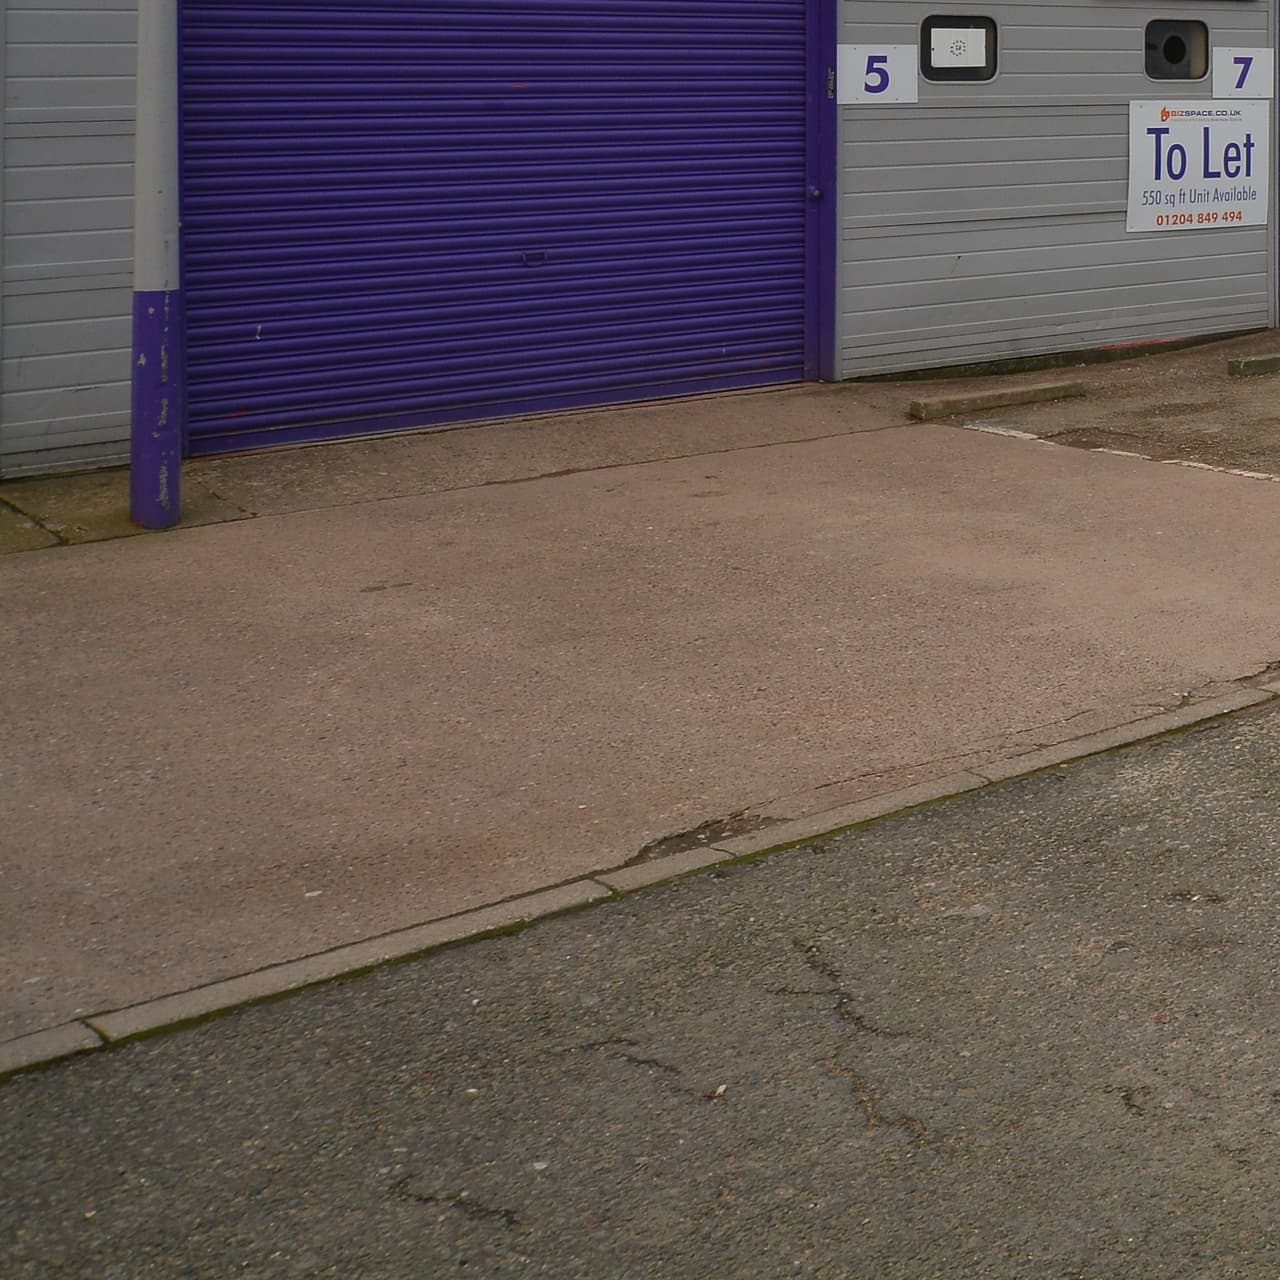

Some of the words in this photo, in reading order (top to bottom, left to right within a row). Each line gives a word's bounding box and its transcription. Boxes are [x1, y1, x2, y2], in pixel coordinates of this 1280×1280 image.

[864, 55, 890, 94] 5
[1233, 56, 1254, 89] 7
[1146, 127, 1187, 181] To
[1203, 126, 1255, 179] Let
[1142, 190, 1162, 206] 550
[1164, 192, 1175, 207] sq
[1179, 188, 1186, 204] ft
[1189, 188, 1210, 204] Unit
[1212, 186, 1257, 203] Available
[1156, 213, 1193, 226] 01204
[1197, 212, 1218, 224] 849
[1222, 210, 1242, 222] 494
